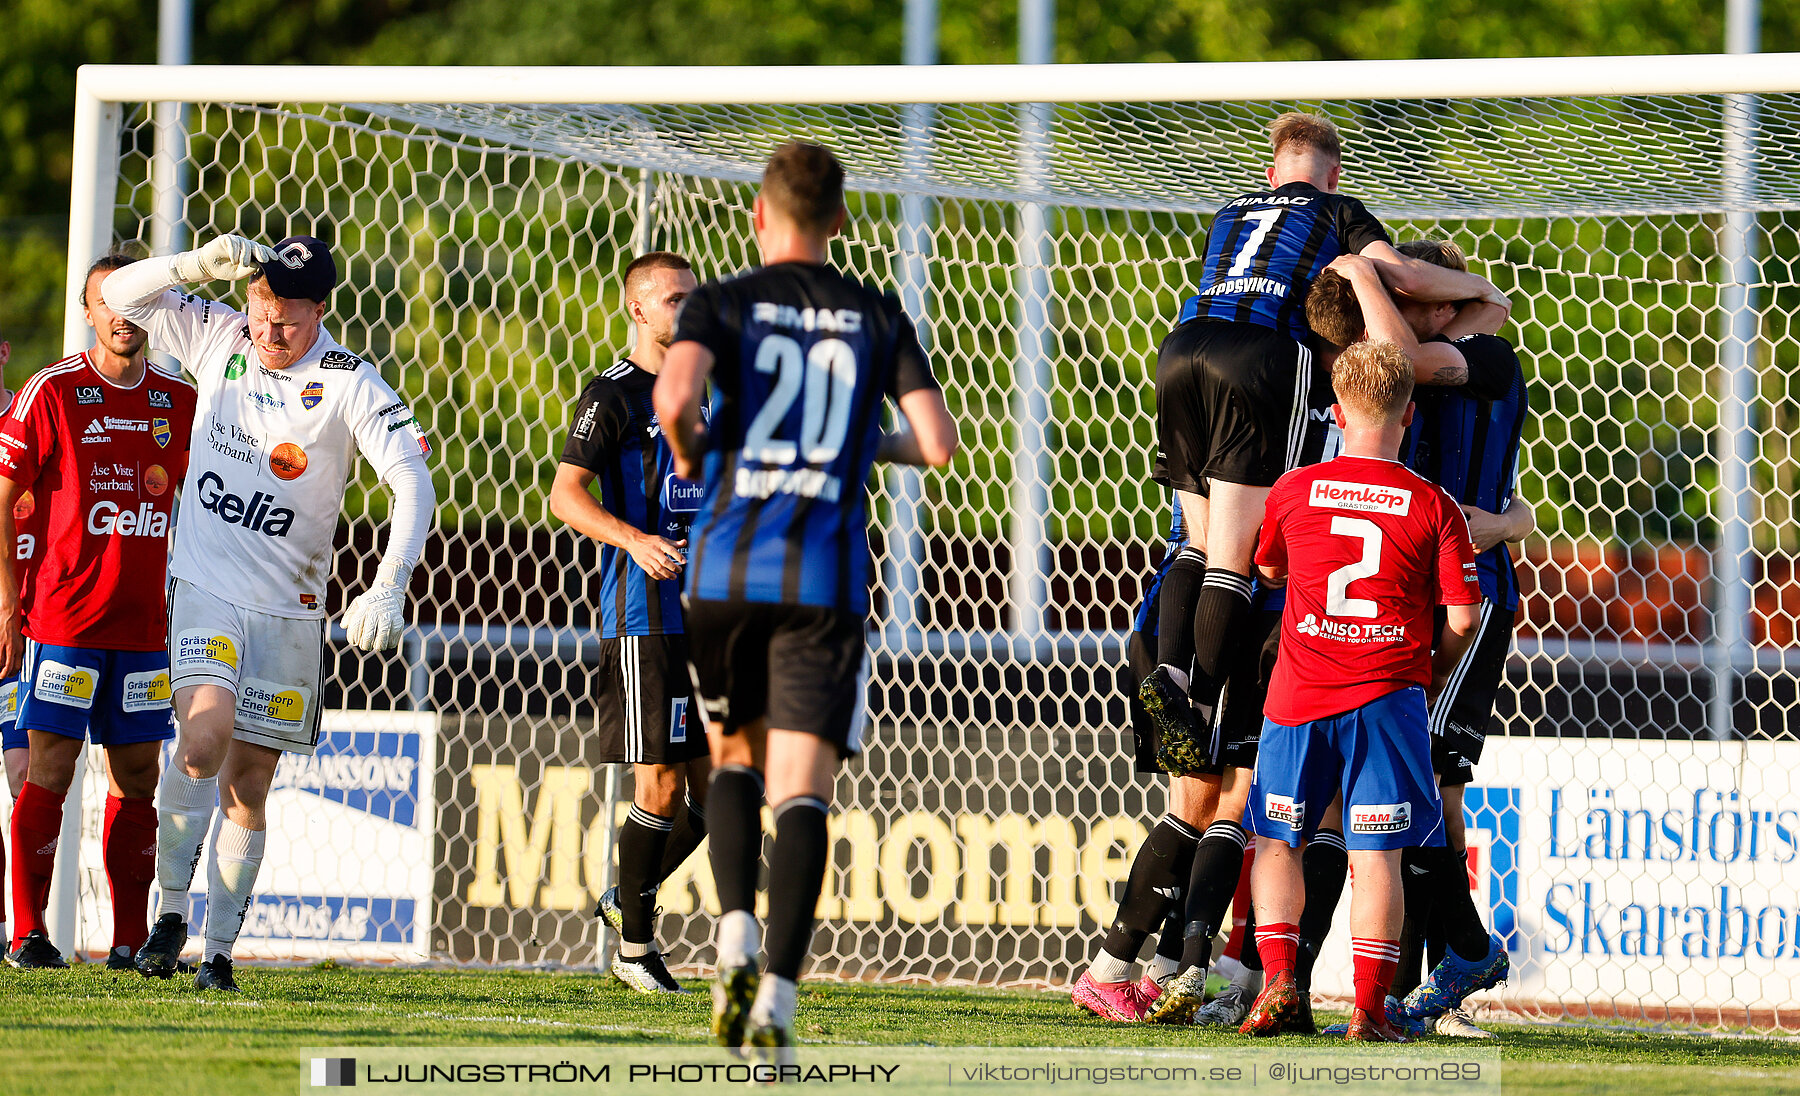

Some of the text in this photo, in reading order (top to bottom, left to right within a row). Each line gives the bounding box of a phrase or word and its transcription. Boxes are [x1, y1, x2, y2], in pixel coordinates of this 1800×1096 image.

[1228, 208, 1283, 277] 7
[278, 243, 314, 269] G
[1201, 277, 1287, 298] PPSVIKEN
[326, 351, 360, 366] LOK
[76, 387, 102, 398] LOK
[149, 390, 170, 403] LOK
[743, 335, 857, 465] 20
[81, 436, 112, 444] stadium
[230, 424, 259, 447] Viste
[207, 430, 255, 465] Sarbank
[91, 462, 134, 477] Åse Viste
[89, 479, 134, 493] Sparbank
[197, 471, 295, 537] Gelia
[1315, 483, 1404, 509] Hemköp
[88, 500, 168, 538] Gelia
[1326, 516, 1383, 618] 2
[1318, 631, 1346, 642] KEEPING
[1320, 619, 1405, 638] NISO TECH
[180, 636, 228, 651] Grästorp
[180, 647, 217, 658] Energi
[44, 669, 85, 685] Grästorp
[127, 679, 164, 691] Grästorp
[41, 679, 73, 694] Energi
[127, 690, 156, 700] Energi
[244, 686, 294, 708] Grästorp
[241, 698, 280, 716] Energi
[1355, 813, 1391, 823] TEAM
